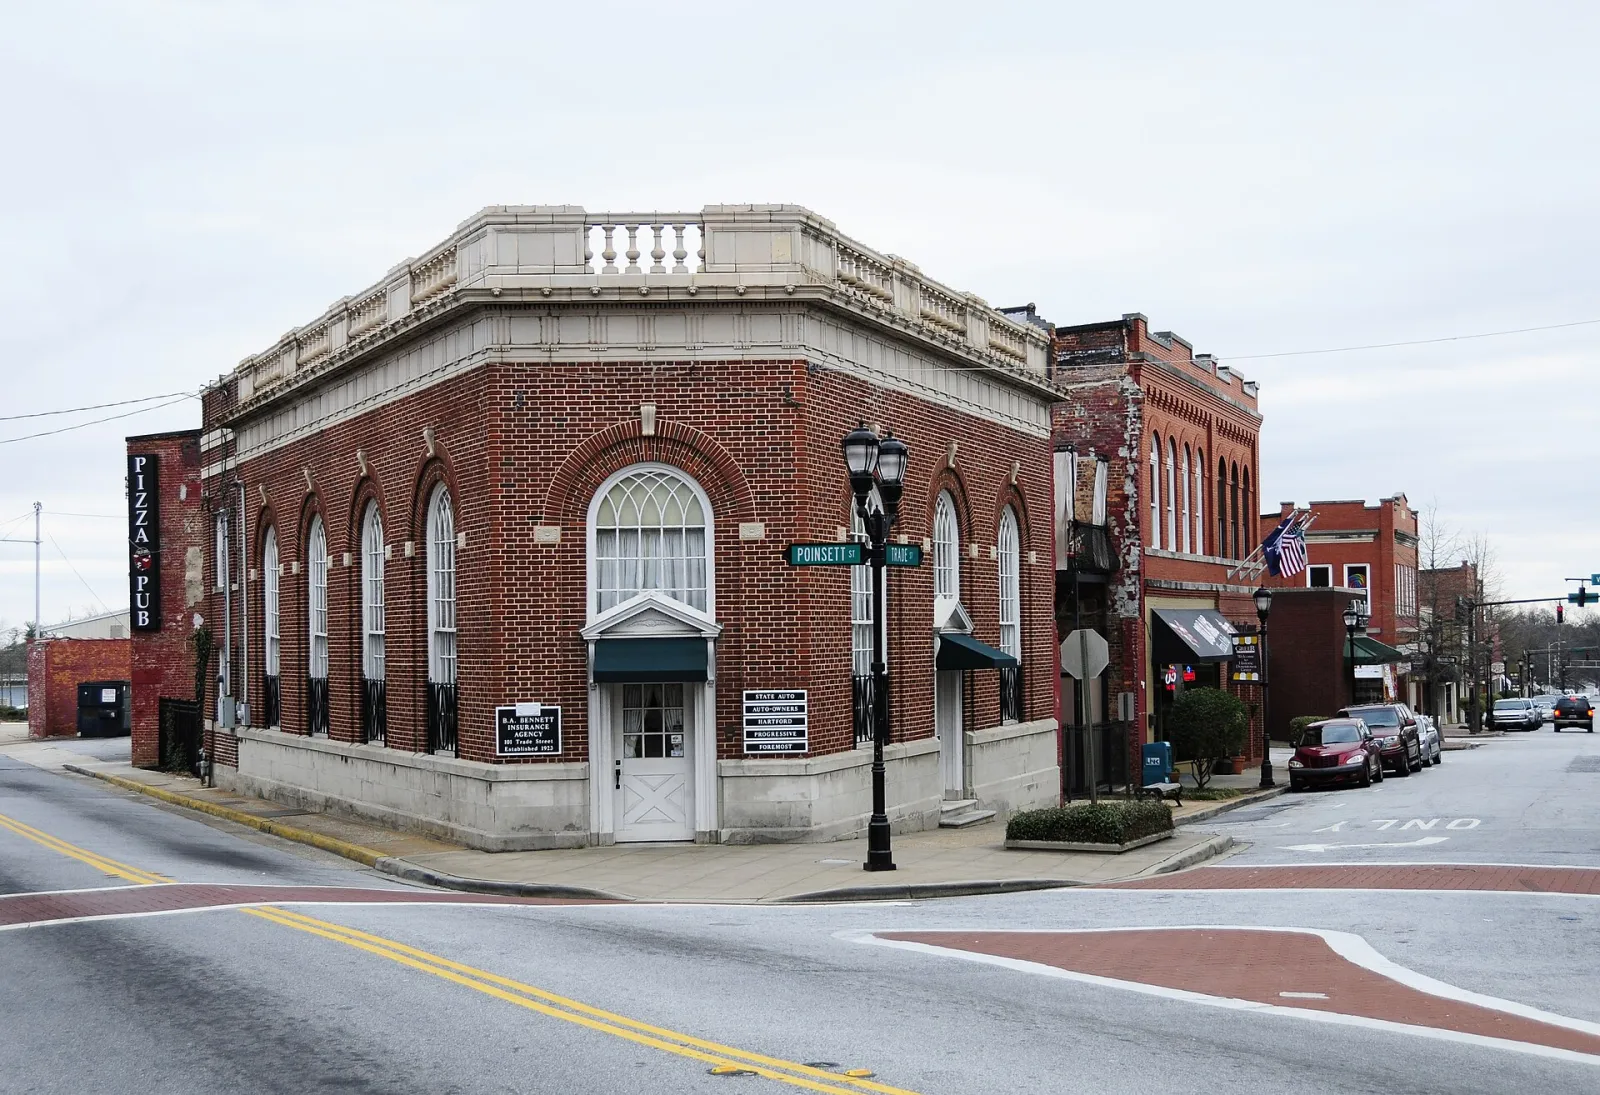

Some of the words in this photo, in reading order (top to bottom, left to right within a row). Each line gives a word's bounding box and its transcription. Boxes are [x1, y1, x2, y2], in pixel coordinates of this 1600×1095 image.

[134, 457, 149, 543] PIZZA
[797, 547, 846, 562] POINSETT
[848, 550, 855, 558] ST
[891, 547, 908, 562] TRADE
[136, 576, 150, 627] PUB
[507, 723, 550, 731] INSURANCE
